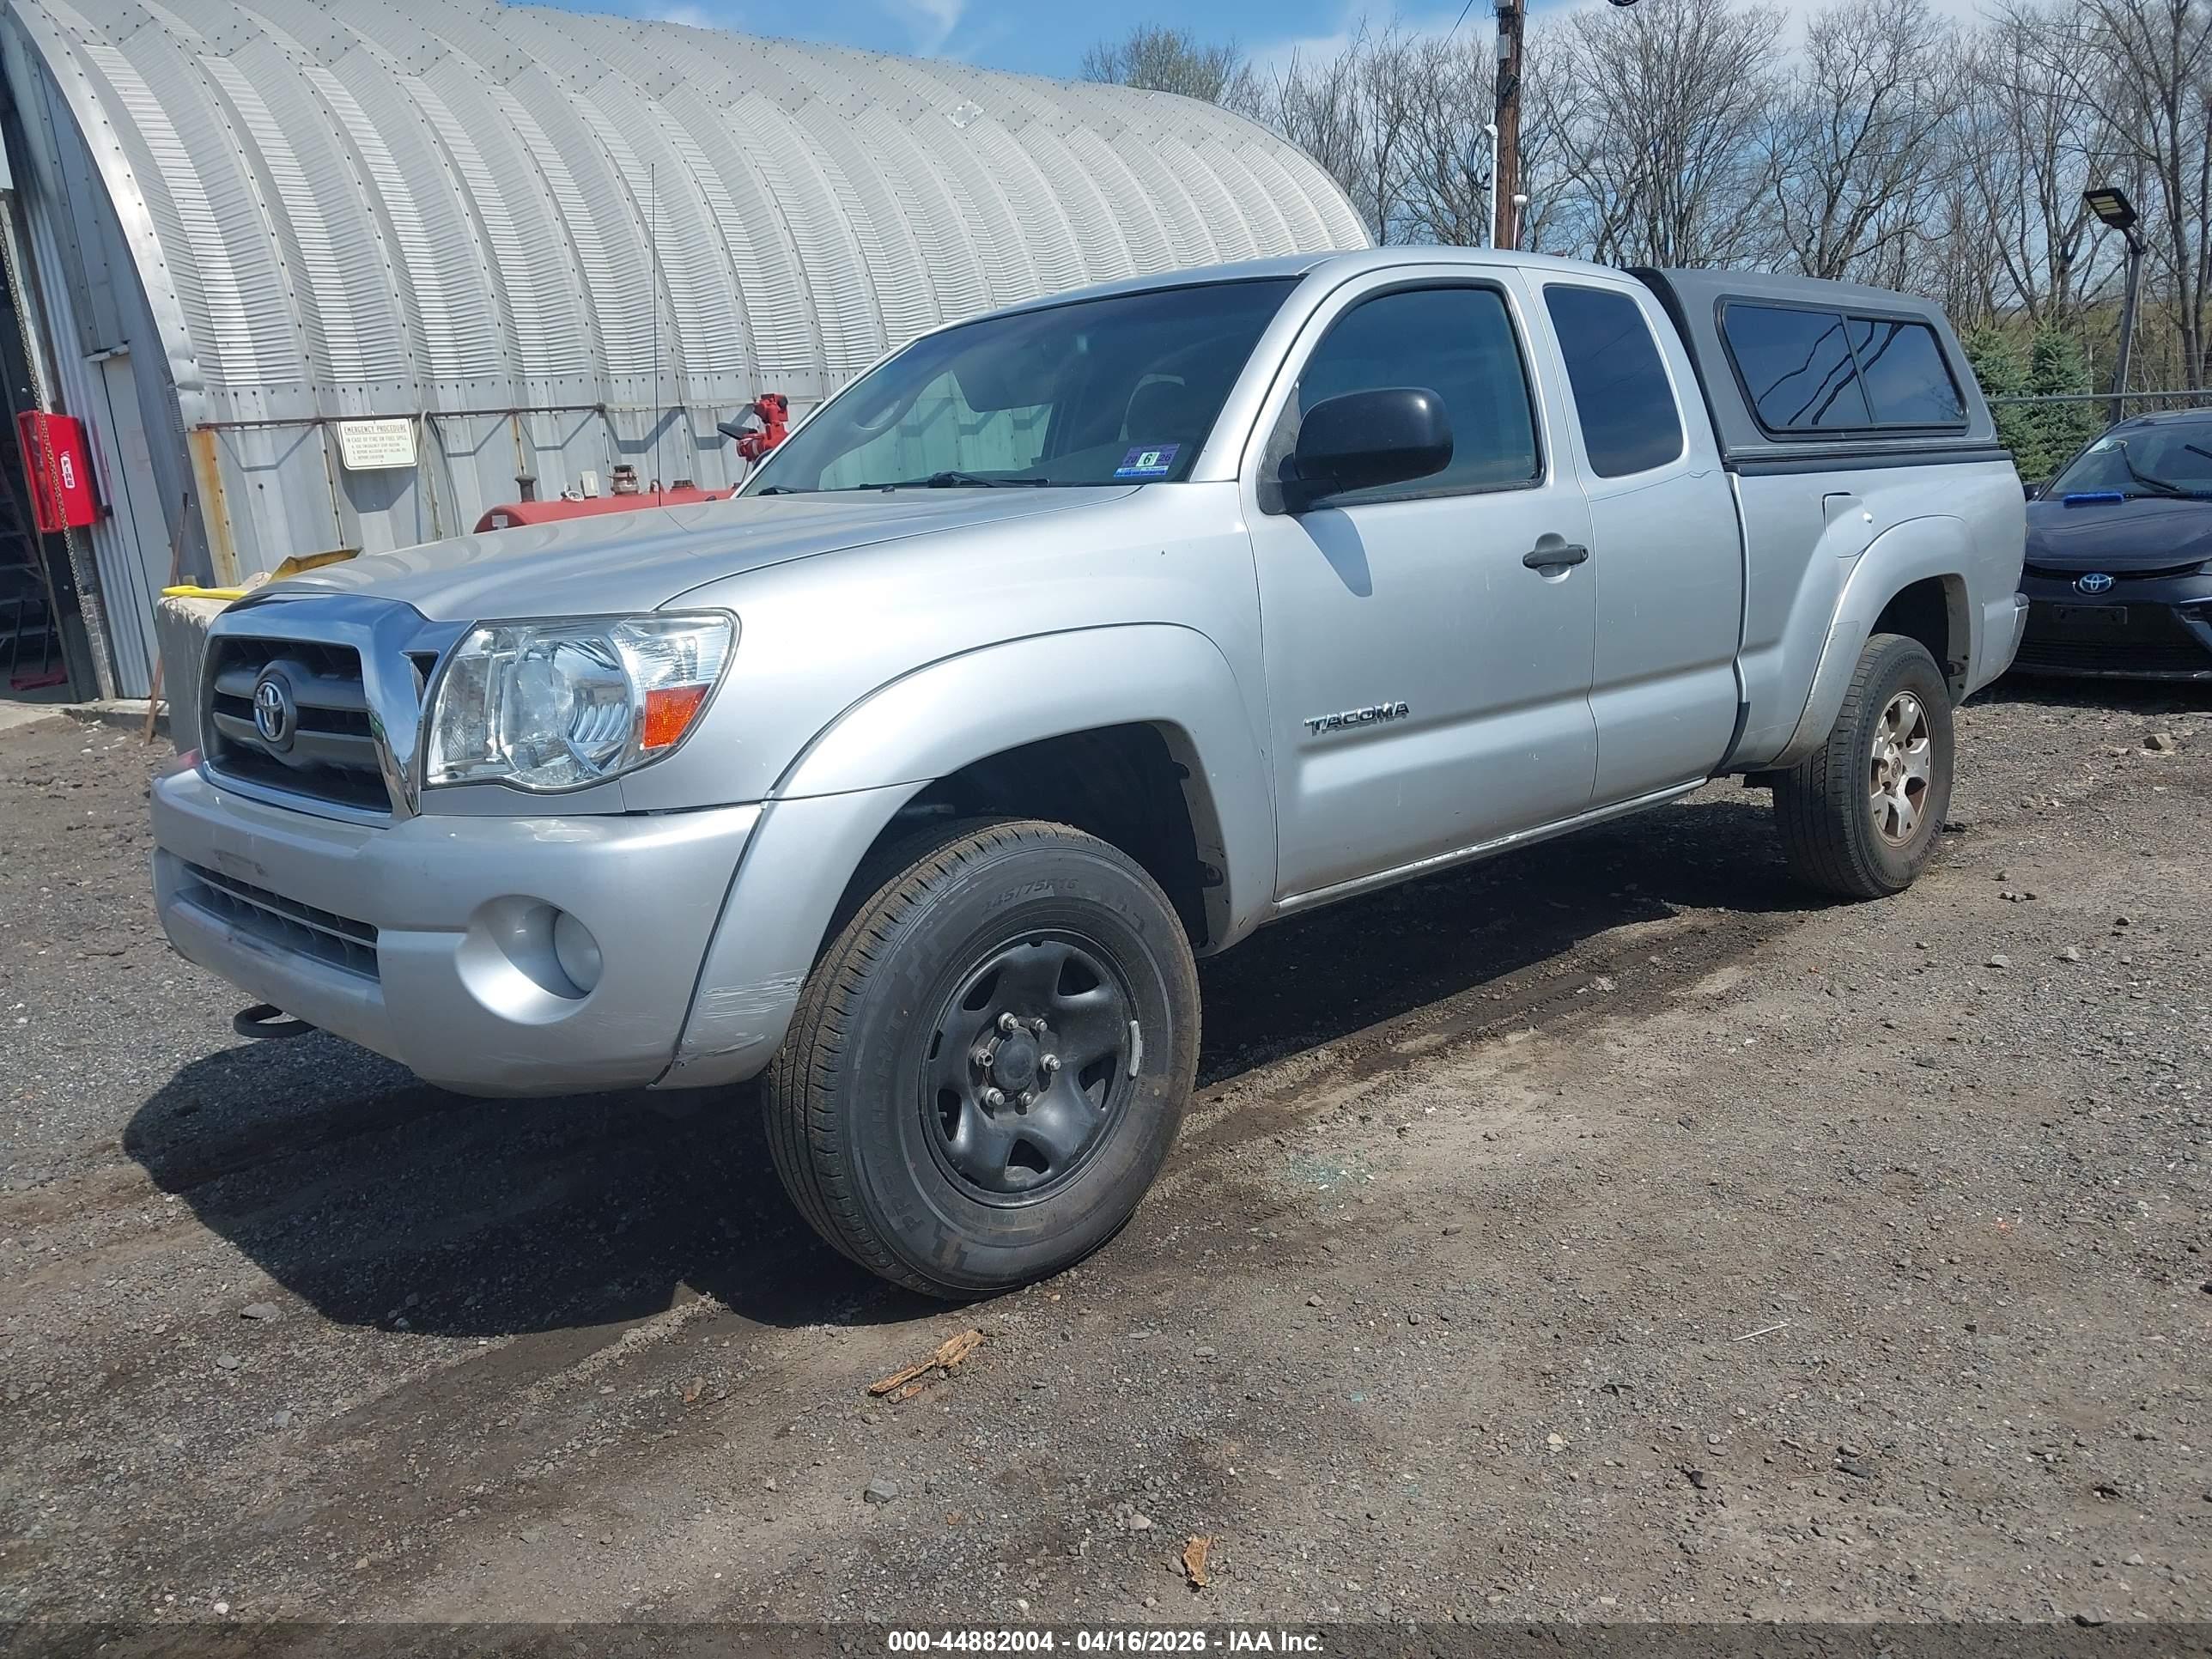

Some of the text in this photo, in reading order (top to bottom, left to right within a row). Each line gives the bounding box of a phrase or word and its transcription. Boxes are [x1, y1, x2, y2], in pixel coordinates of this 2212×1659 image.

[344, 424, 407, 434] EMERGENCY PROCEDURE
[1143, 453, 1152, 465] 6
[1158, 453, 1172, 462] 26
[63, 459, 74, 487] FIRE
[1304, 701, 1409, 733] TACOMA
